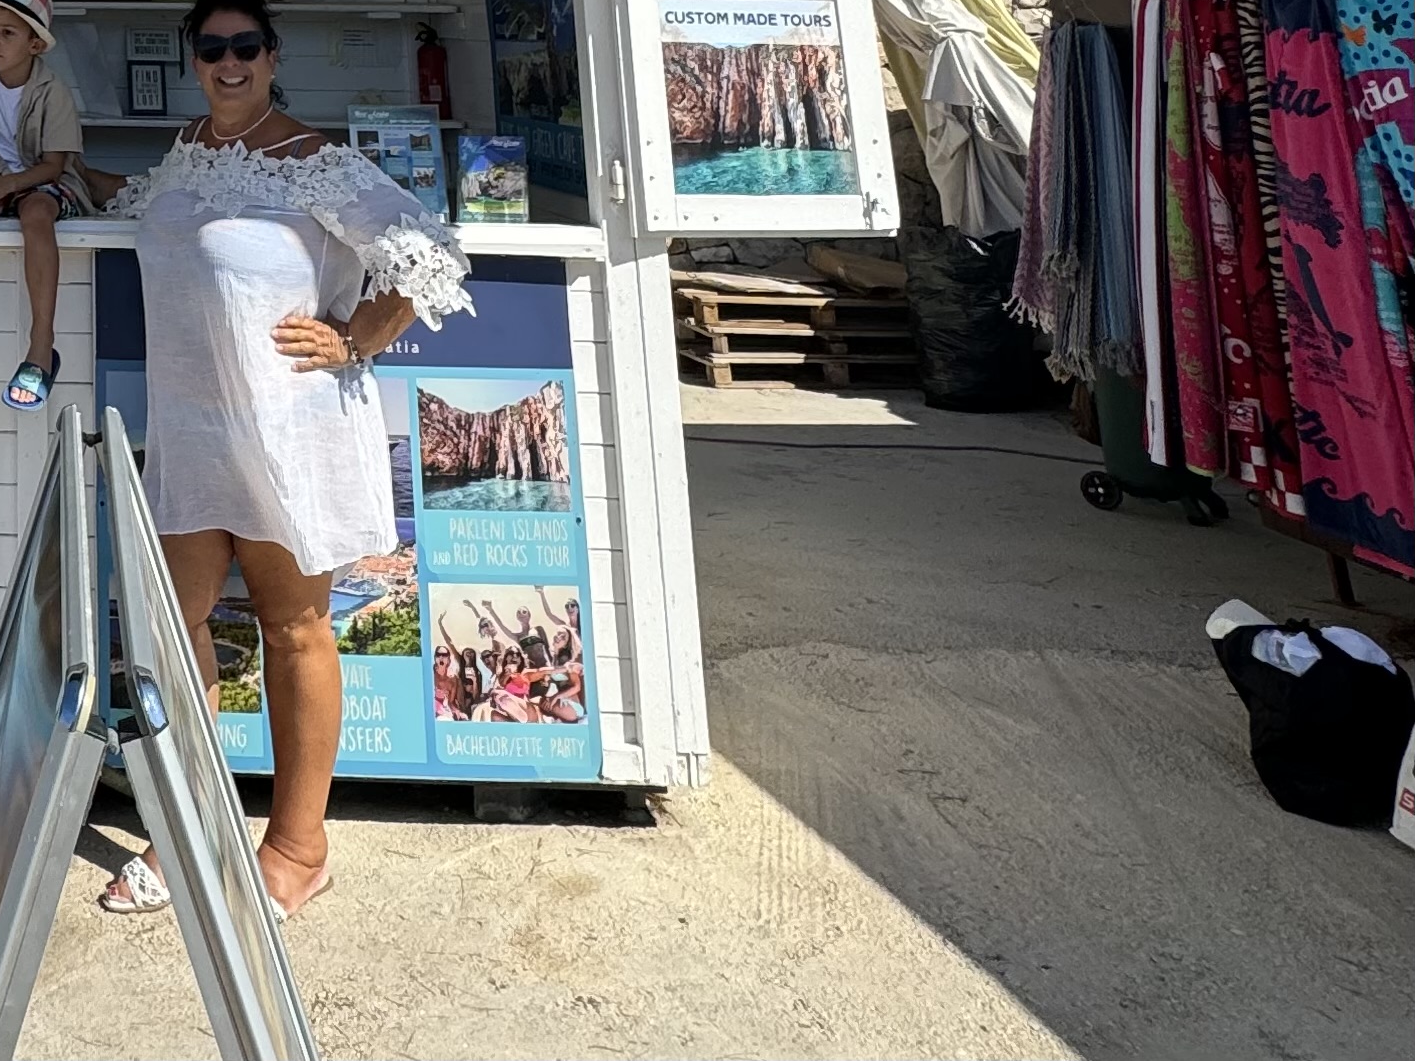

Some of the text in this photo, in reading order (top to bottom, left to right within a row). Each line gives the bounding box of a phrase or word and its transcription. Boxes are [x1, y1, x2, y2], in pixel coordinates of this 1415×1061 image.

[665, 11, 832, 28] CUSTOM MADE TOURS
[385, 340, 420, 354] atia
[449, 517, 569, 543] PAKLENI ISLANDS
[453, 542, 478, 567] RED
[486, 543, 528, 568] ROCKS
[536, 544, 570, 569] TOUR
[343, 664, 373, 690] VATE
[342, 695, 388, 721] DBOAT
[340, 727, 392, 753] NSFERS
[446, 733, 585, 760] BACHELOR/ETTE PARTY
